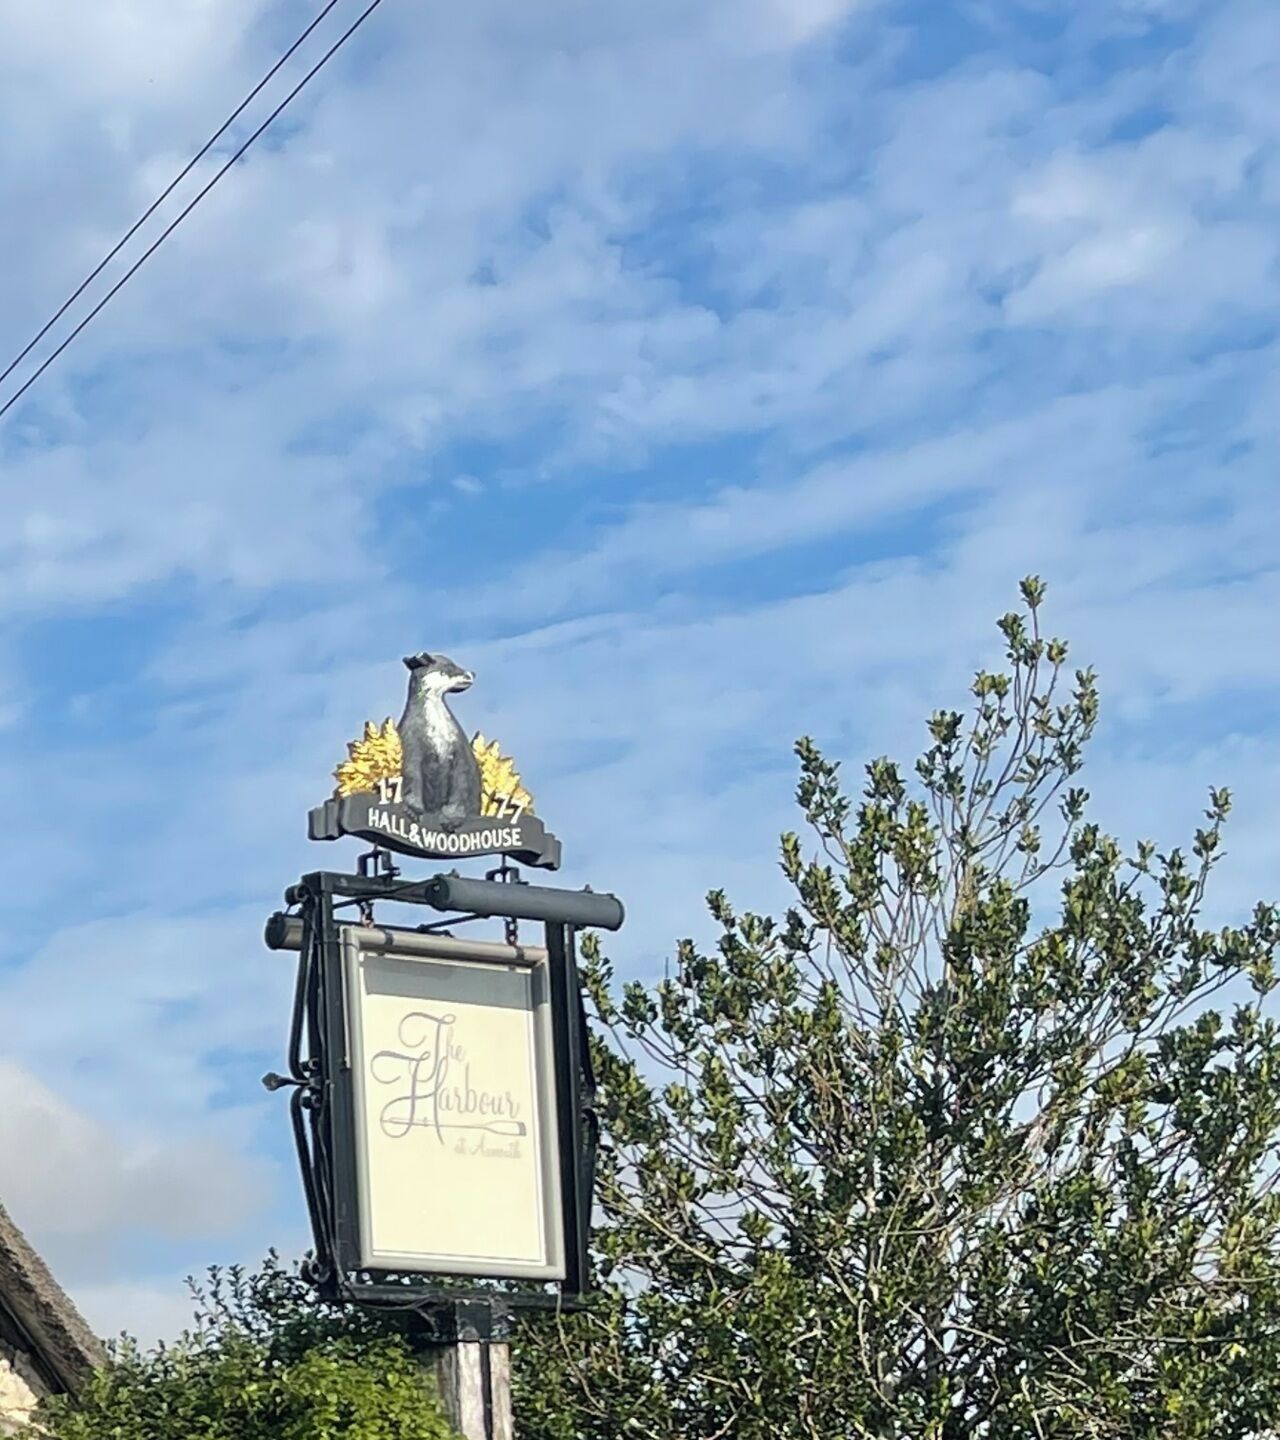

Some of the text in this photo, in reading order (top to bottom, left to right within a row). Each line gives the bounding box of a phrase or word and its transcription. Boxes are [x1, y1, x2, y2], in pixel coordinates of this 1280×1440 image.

[377, 776, 524, 825] 17 77
[398, 1011, 466, 1083] The
[370, 1050, 521, 1146] Harbour
